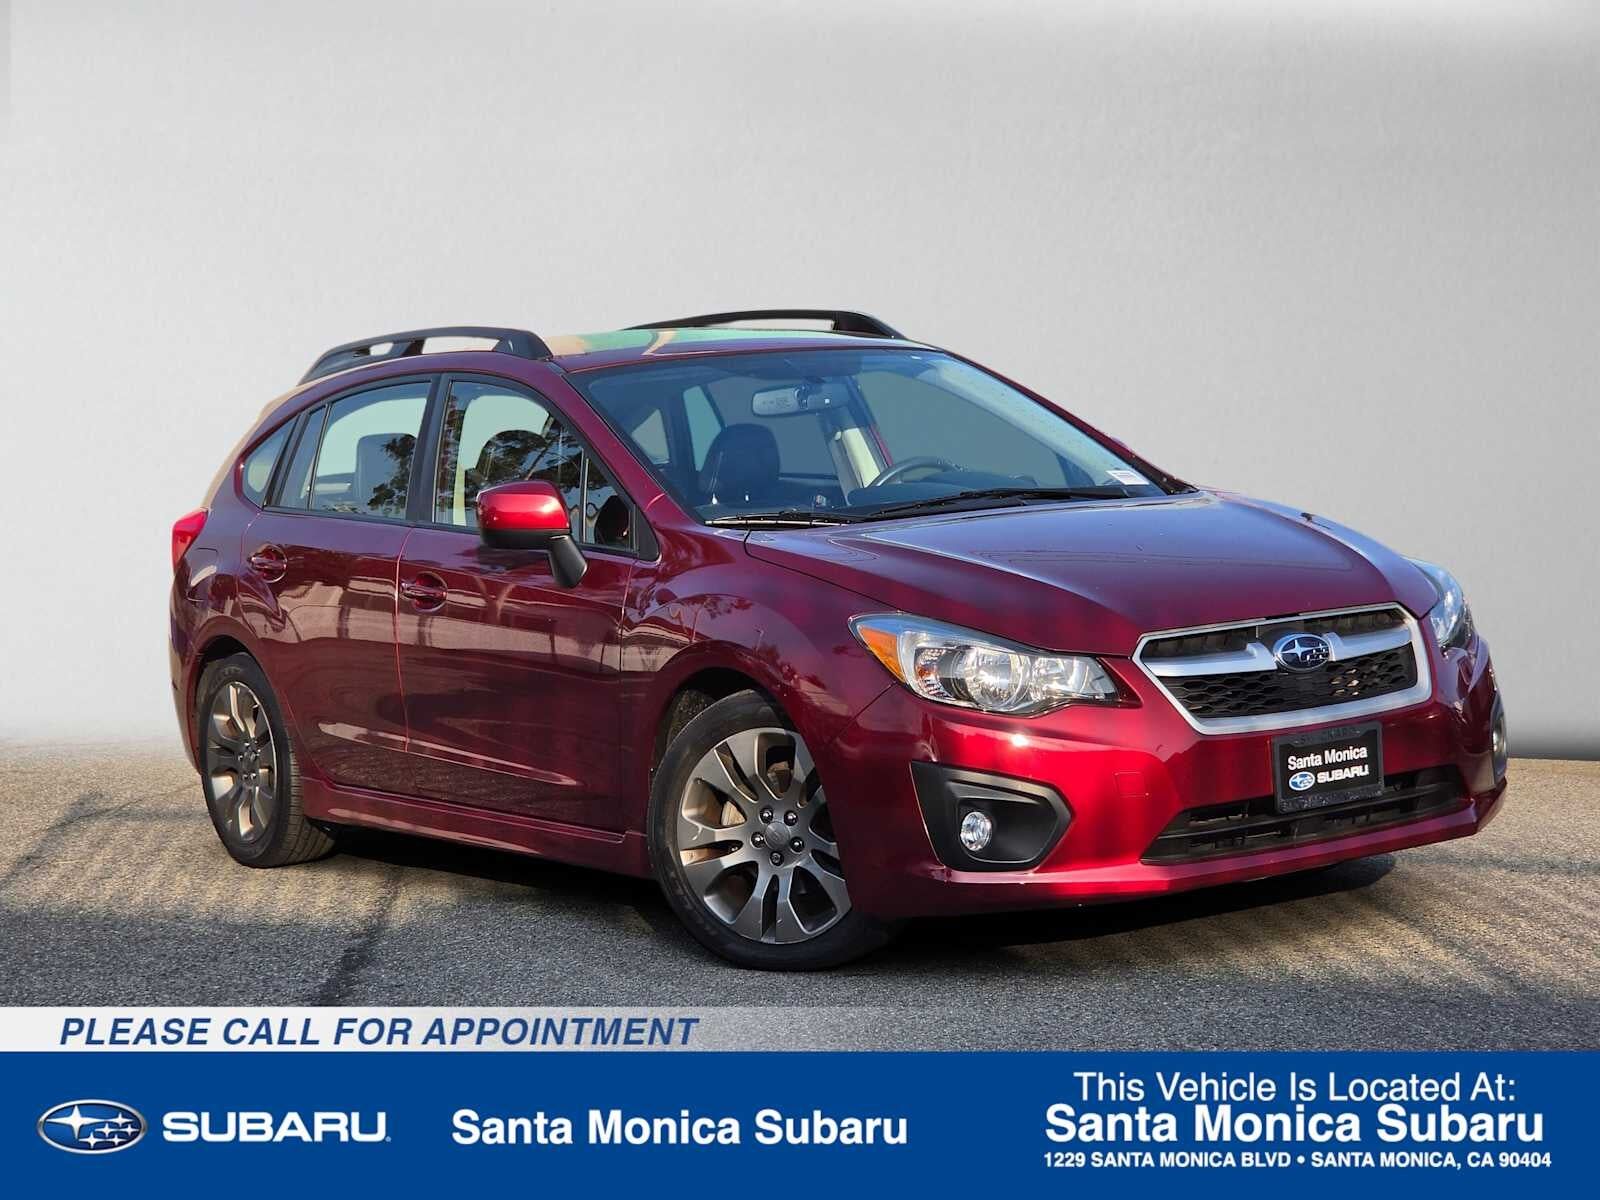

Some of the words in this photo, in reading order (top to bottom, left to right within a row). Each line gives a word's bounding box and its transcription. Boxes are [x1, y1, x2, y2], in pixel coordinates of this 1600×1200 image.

[1287, 753, 1322, 770] Santa
[1324, 746, 1368, 764] Monica
[1317, 765, 1369, 783] SUBARU
